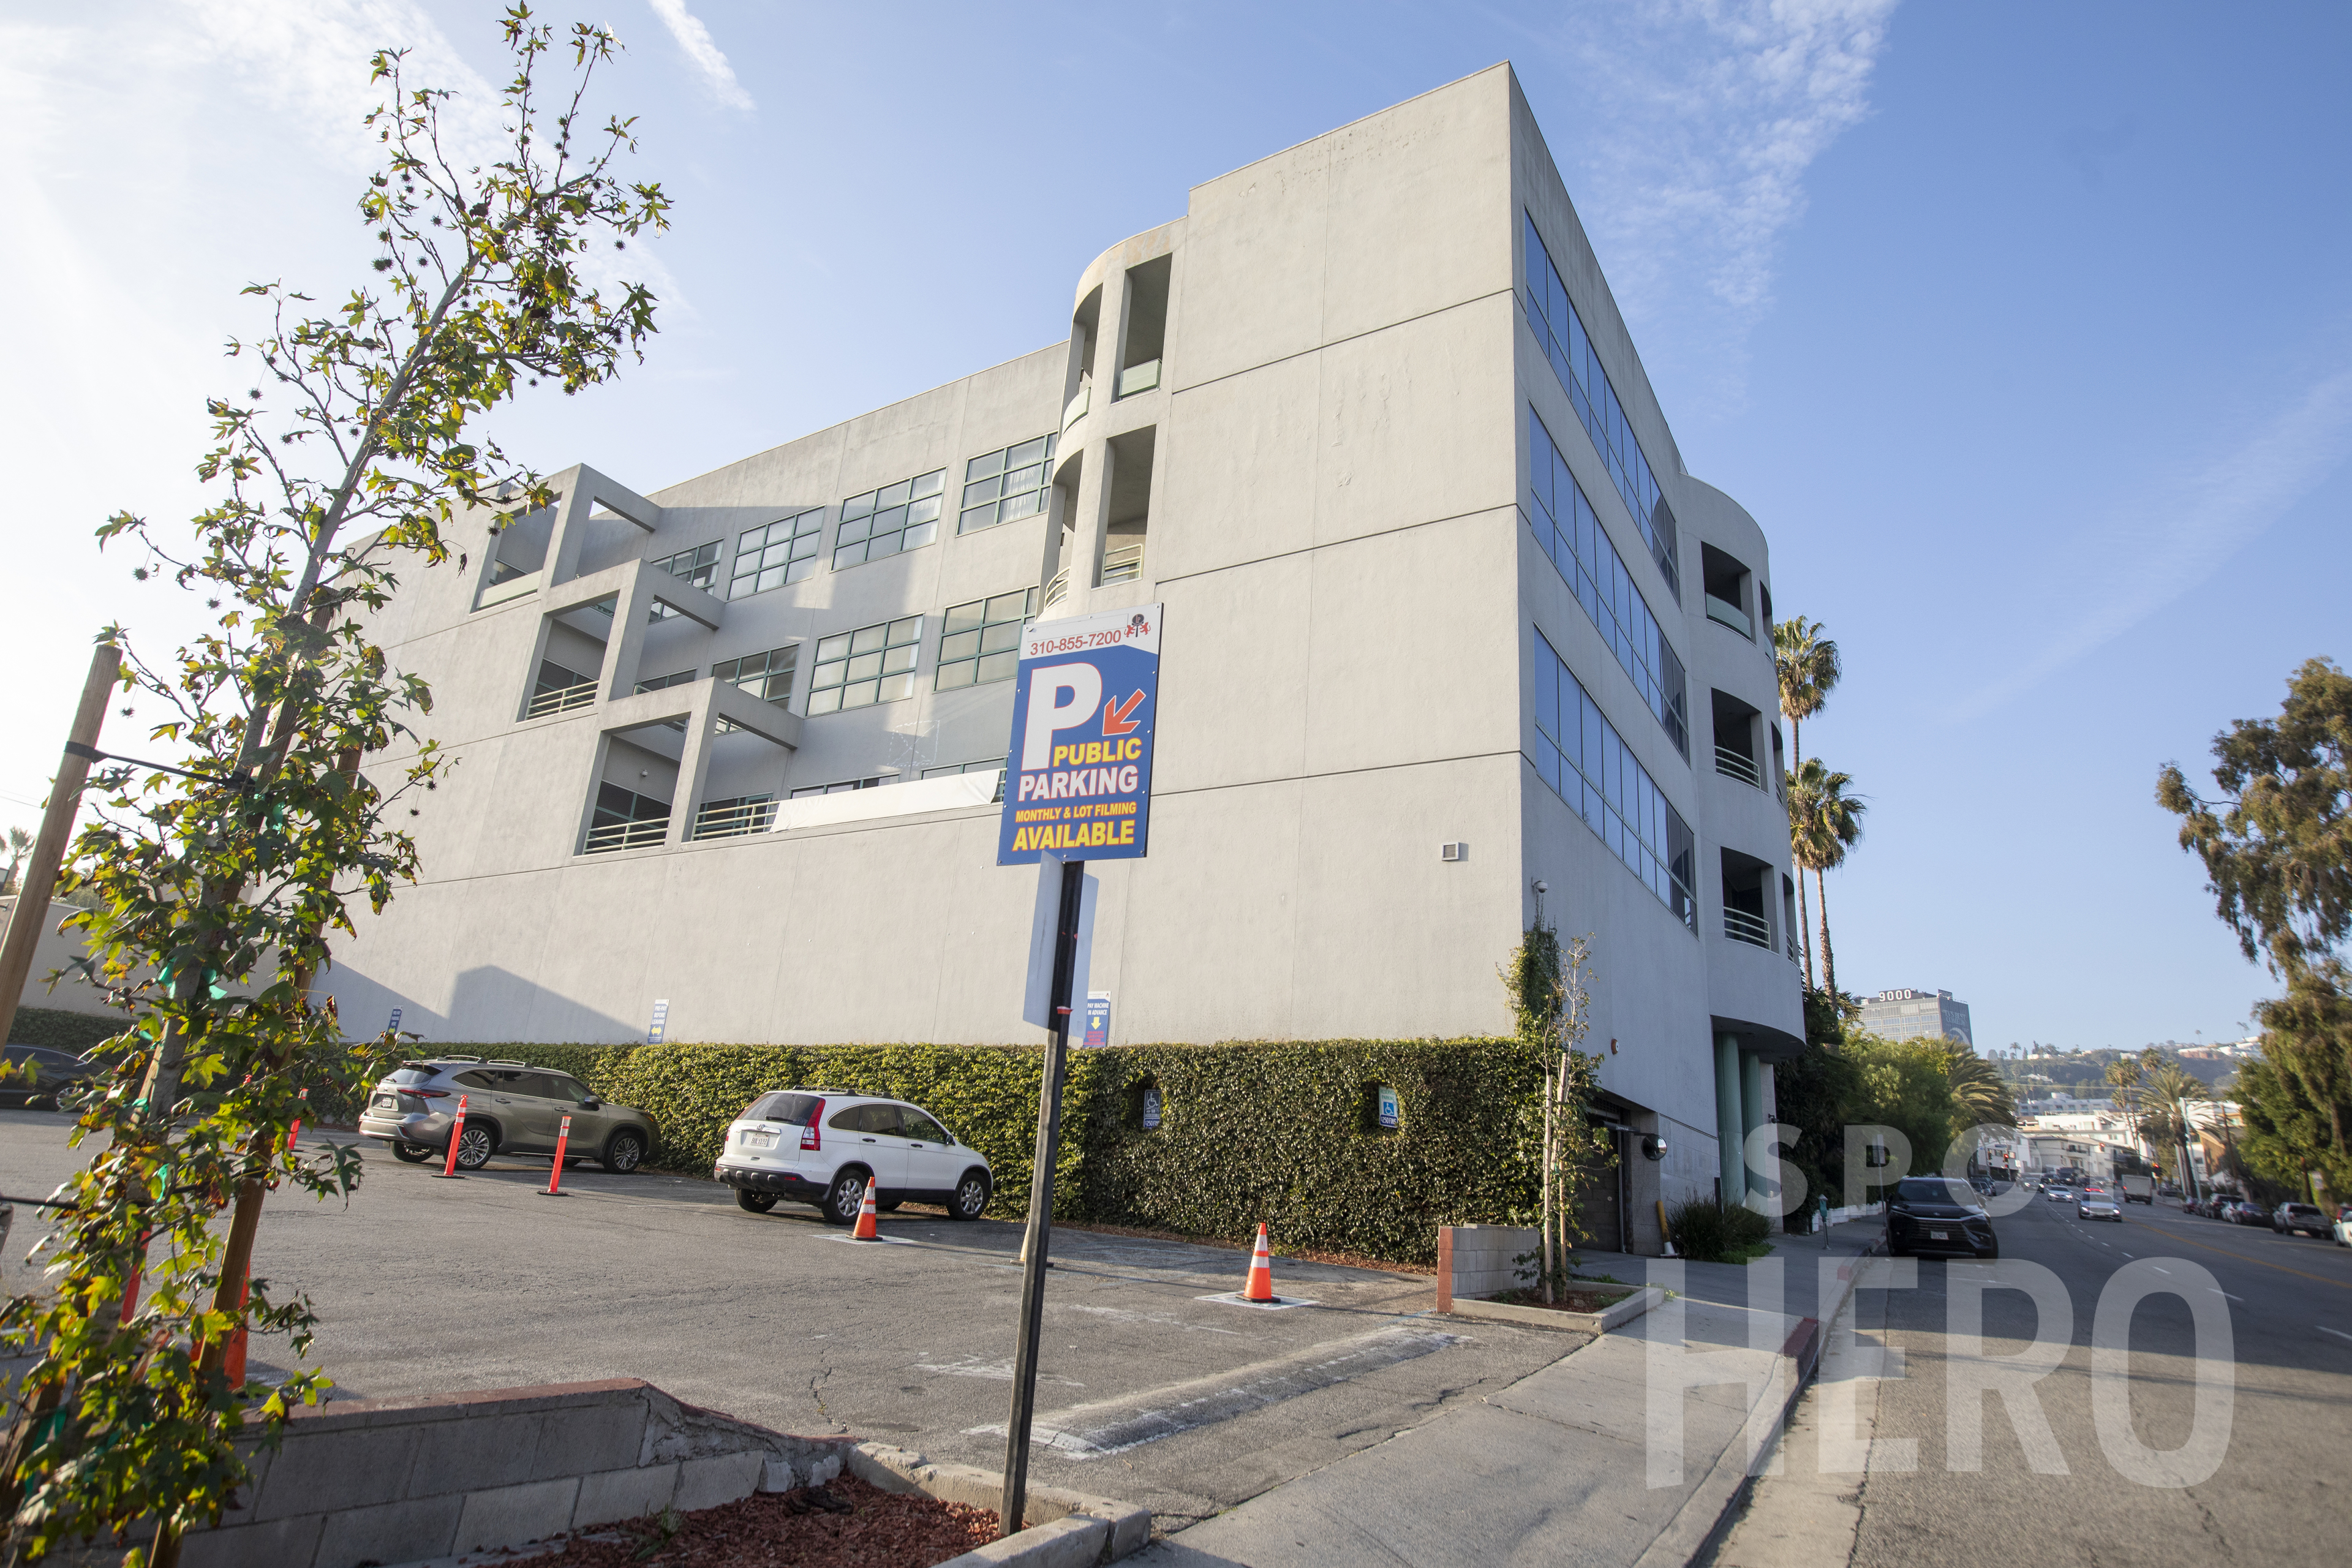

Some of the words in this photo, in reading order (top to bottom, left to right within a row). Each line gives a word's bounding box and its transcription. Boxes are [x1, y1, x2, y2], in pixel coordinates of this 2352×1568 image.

[1030, 630, 1121, 655] 310-855-7200
[1021, 662, 1102, 772] P
[1052, 737, 1142, 767] PUBLIC
[1017, 765, 1139, 802] PARKING
[1016, 807, 1062, 823] MONTHLY
[1063, 807, 1071, 819] &
[1073, 805, 1093, 818] LOT
[1094, 801, 1137, 816] FILMING
[1011, 820, 1136, 851] AVAILABLE
[1879, 989, 1912, 1002] 9000
